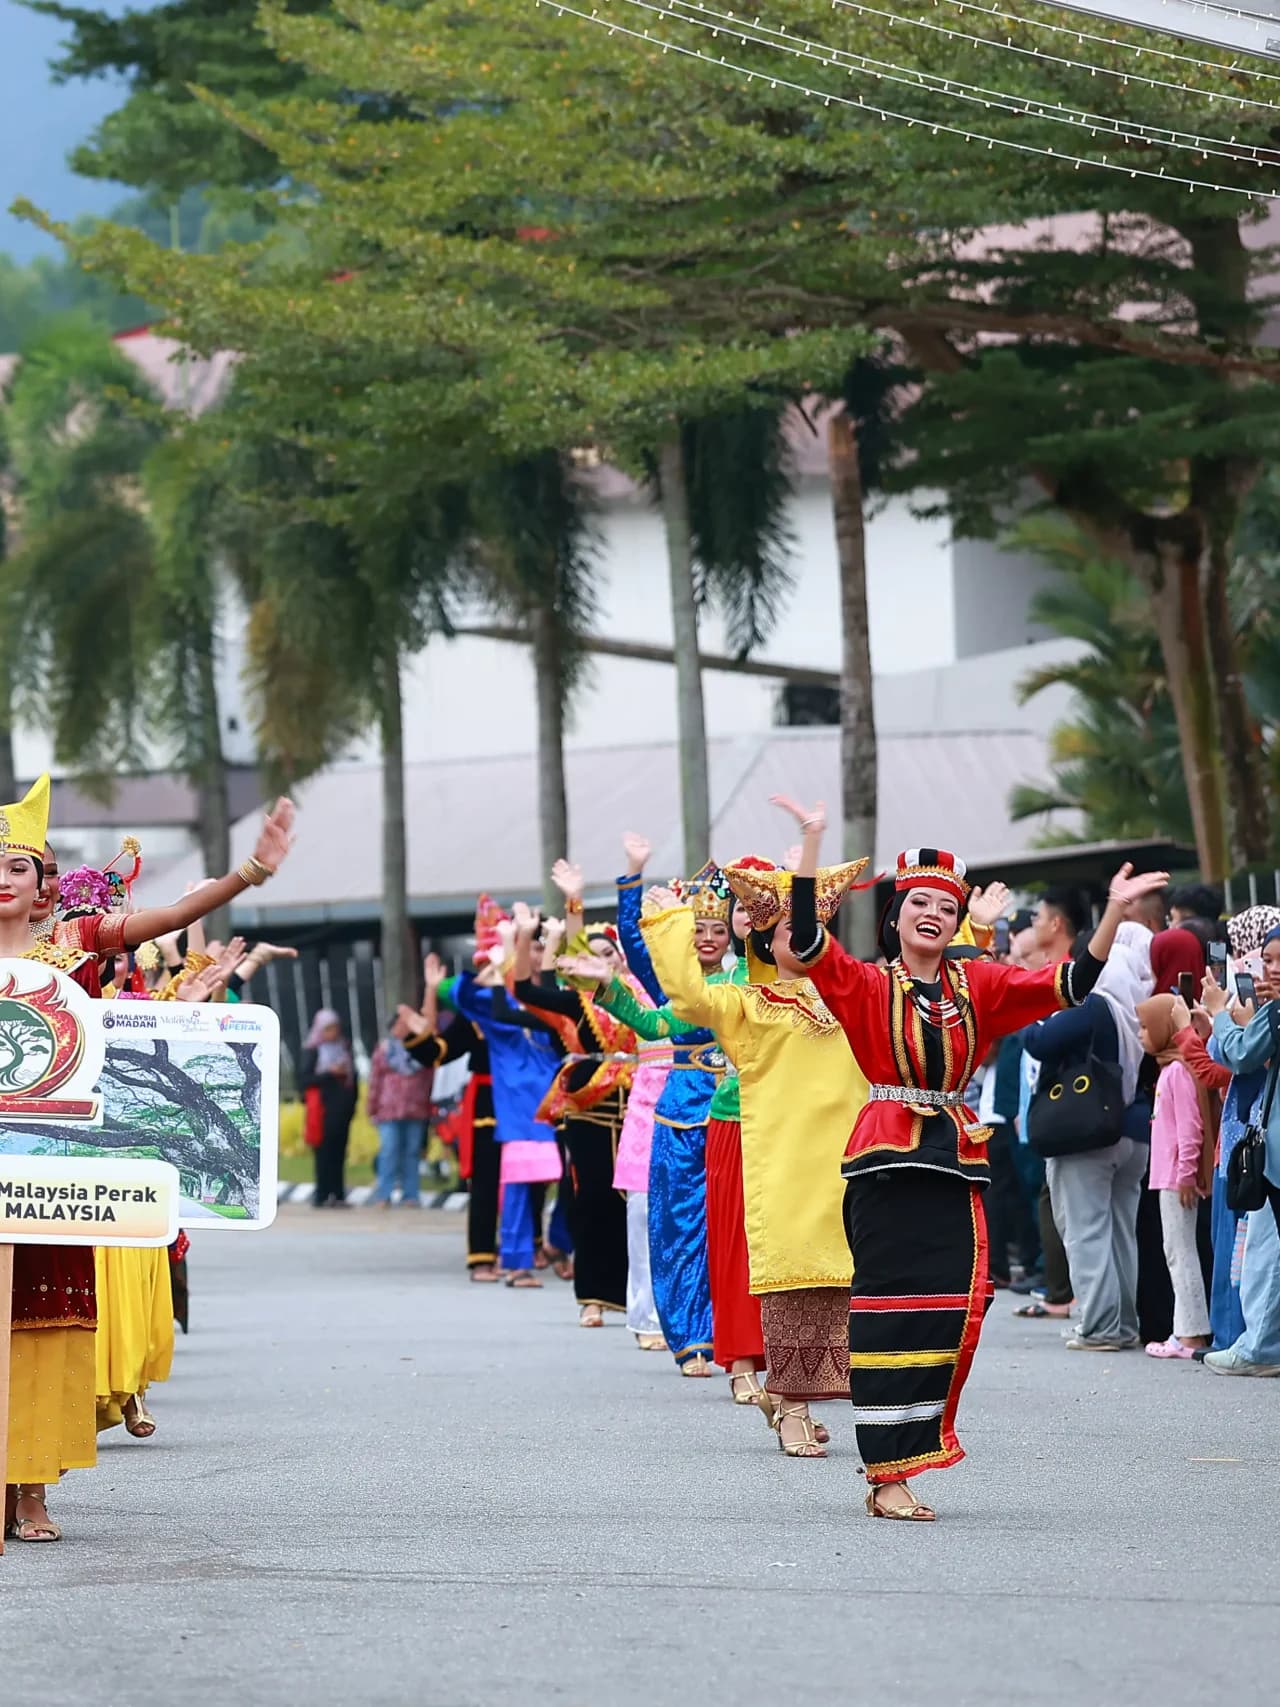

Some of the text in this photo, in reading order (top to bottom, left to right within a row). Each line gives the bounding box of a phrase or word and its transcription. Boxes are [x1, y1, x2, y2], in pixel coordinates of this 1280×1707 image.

[116, 1020, 157, 1028] MADANI
[94, 1184, 158, 1203] Perak
[5, 1202, 117, 1222] MALAYSIA
